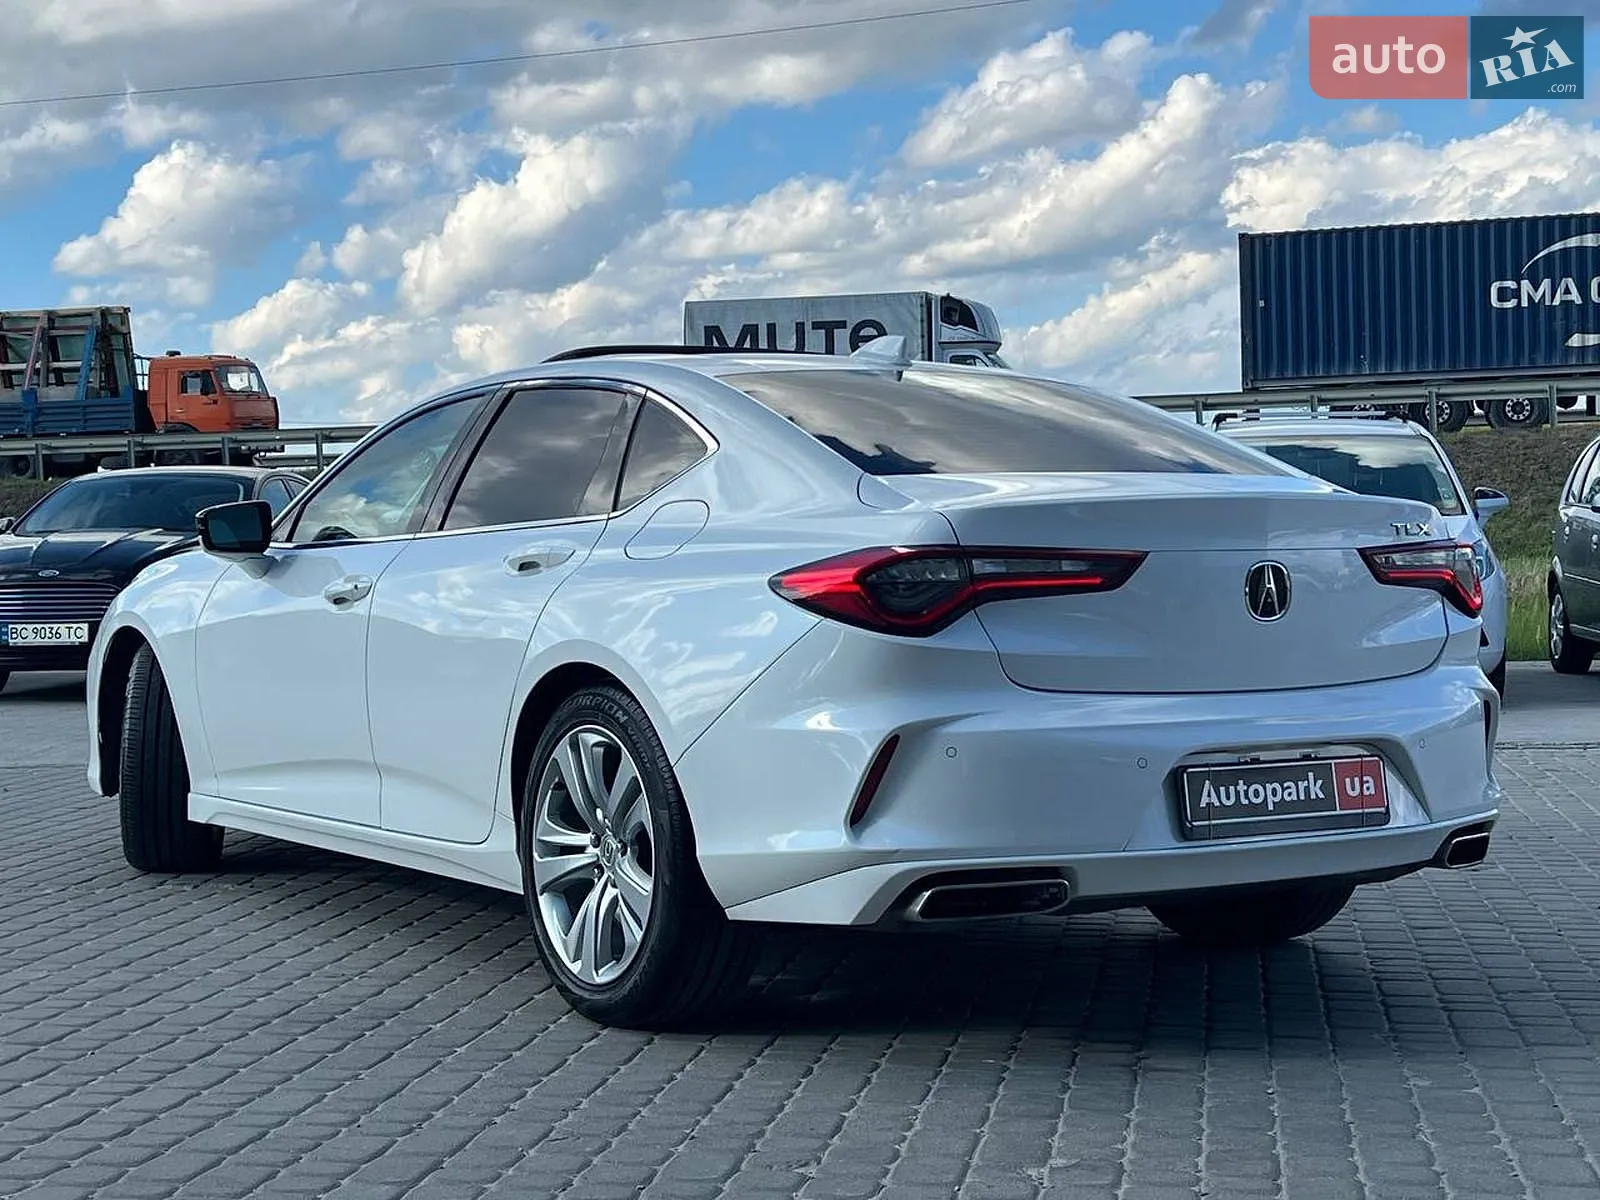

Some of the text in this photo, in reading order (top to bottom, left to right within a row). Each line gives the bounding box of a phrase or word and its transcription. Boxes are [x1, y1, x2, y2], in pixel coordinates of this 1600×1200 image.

[1490, 277, 1583, 309] CMA
[1390, 522, 1432, 537] TLX
[9, 626, 29, 641] BC
[31, 625, 63, 641] 9036
[64, 625, 85, 641] TC
[1199, 771, 1376, 811] Autopark ua
